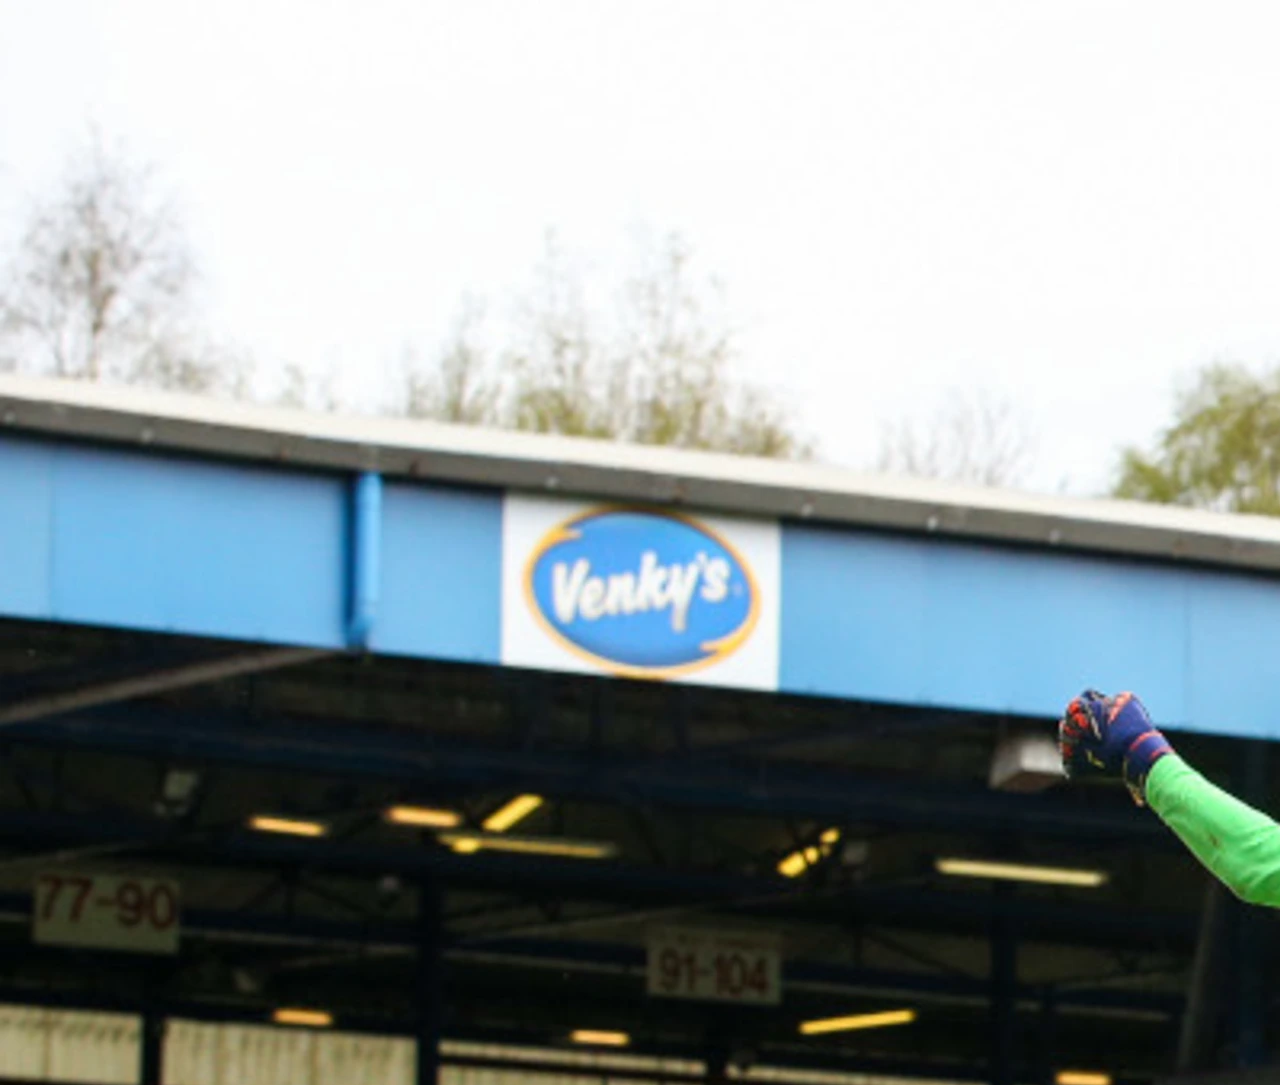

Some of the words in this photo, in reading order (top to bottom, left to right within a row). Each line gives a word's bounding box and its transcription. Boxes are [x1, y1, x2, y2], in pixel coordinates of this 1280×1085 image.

[552, 550, 731, 634] Venky's
[38, 873, 177, 931] 77-90
[659, 949, 770, 998] 91-104
